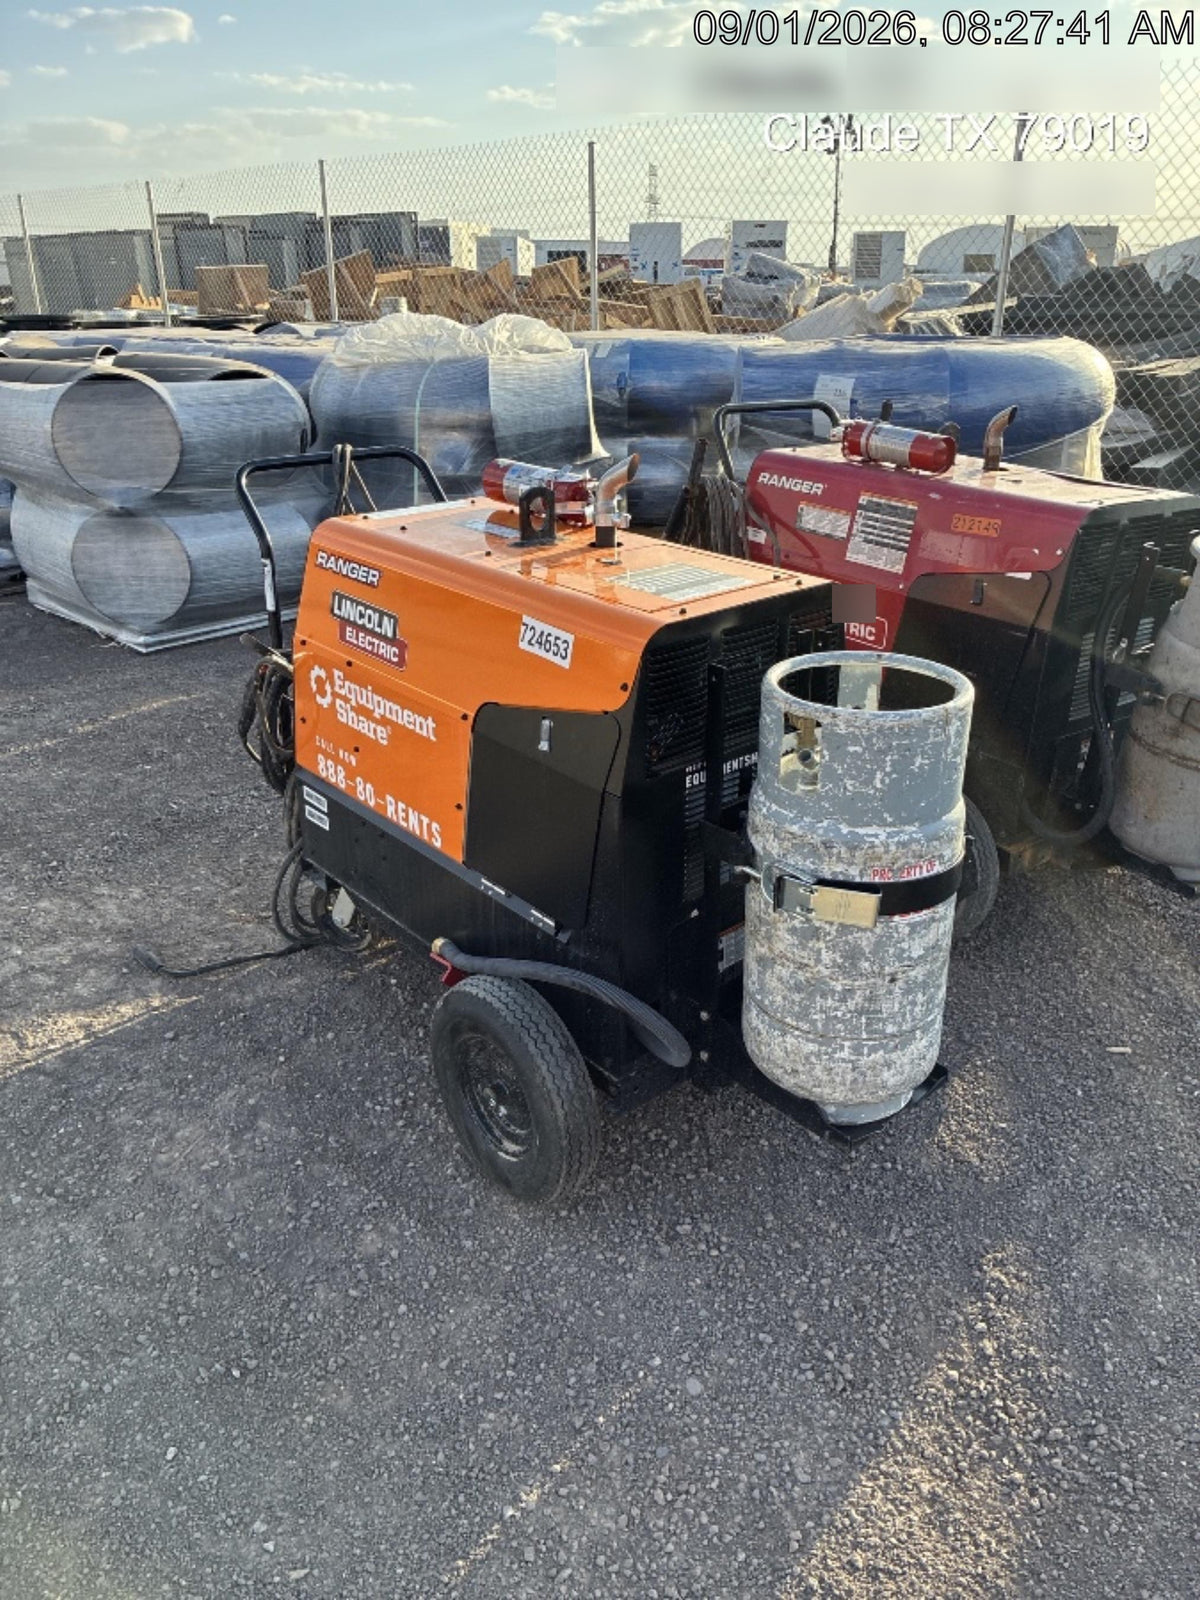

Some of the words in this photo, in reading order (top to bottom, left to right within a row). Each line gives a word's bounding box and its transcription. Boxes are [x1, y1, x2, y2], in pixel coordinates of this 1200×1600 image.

[757, 472, 824, 496] RANGER
[316, 551, 380, 587] RANGER
[333, 594, 395, 640] LINCOLN
[345, 626, 400, 663] ELECTRIC
[520, 621, 570, 661] 724653
[333, 667, 438, 742] Equipment
[317, 752, 442, 849] 888-80-RENTS
